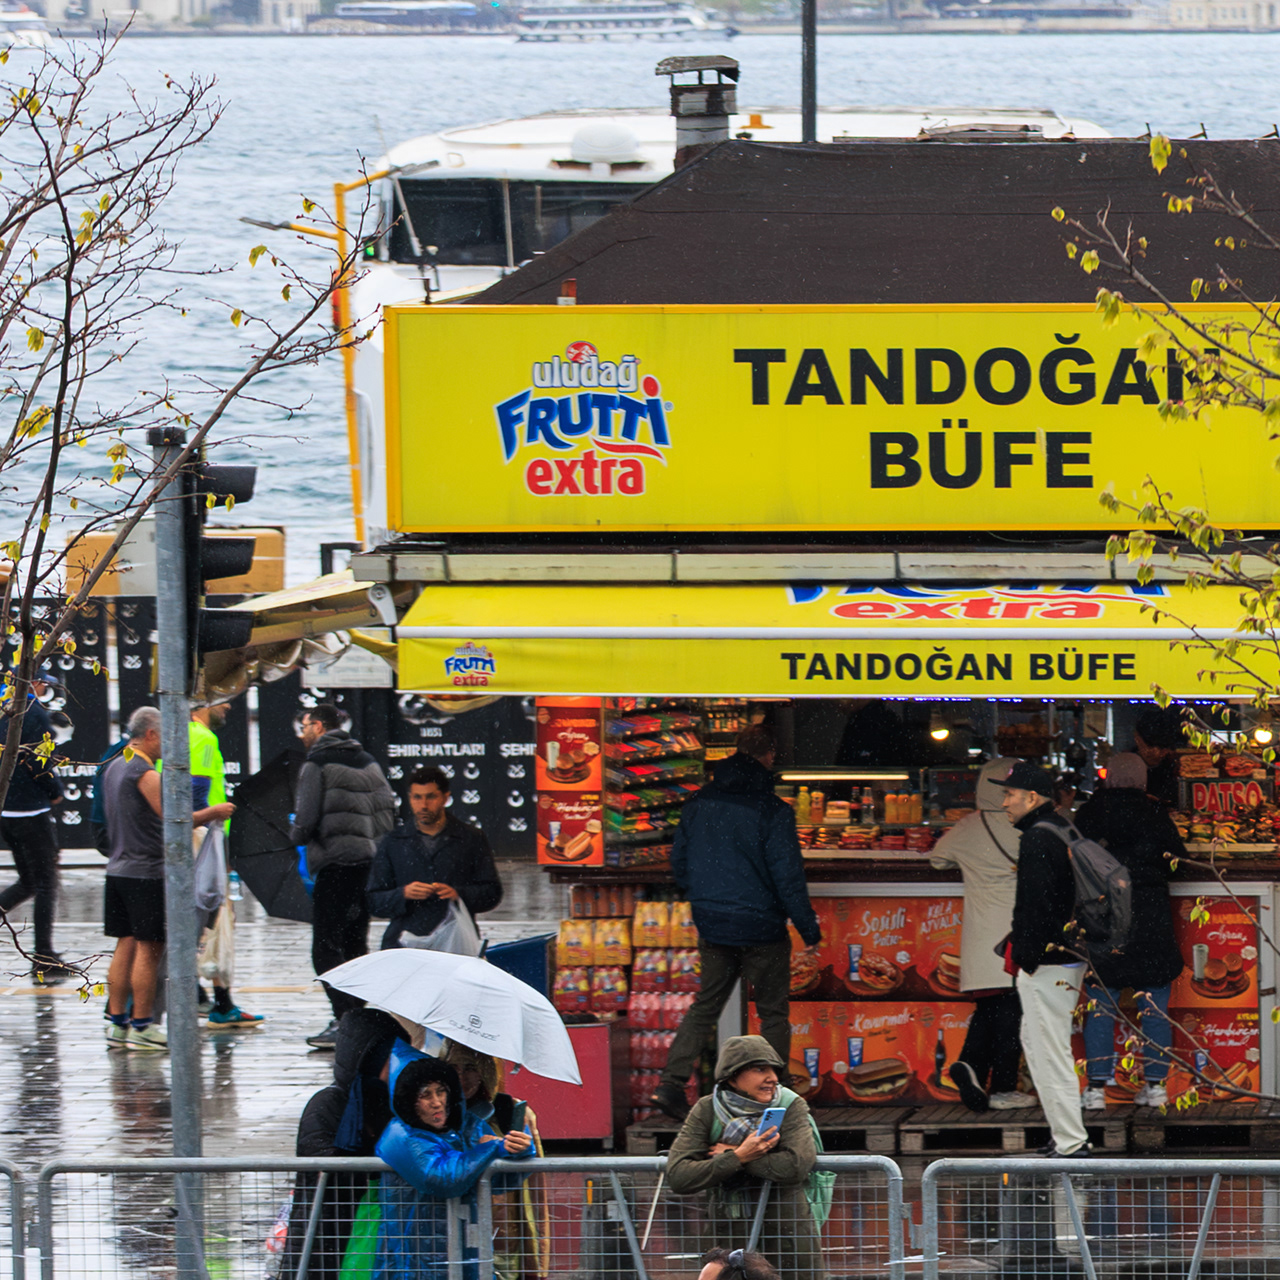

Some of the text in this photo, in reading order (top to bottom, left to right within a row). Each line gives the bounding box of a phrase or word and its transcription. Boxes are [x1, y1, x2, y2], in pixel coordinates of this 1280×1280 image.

[532, 354, 639, 393] uludağ
[869, 418, 1094, 489] BÜFE
[525, 449, 646, 496] extra
[832, 596, 1102, 620] extra
[453, 673, 489, 687] extra
[780, 646, 1137, 681] TANDOĞAN BÜFE
